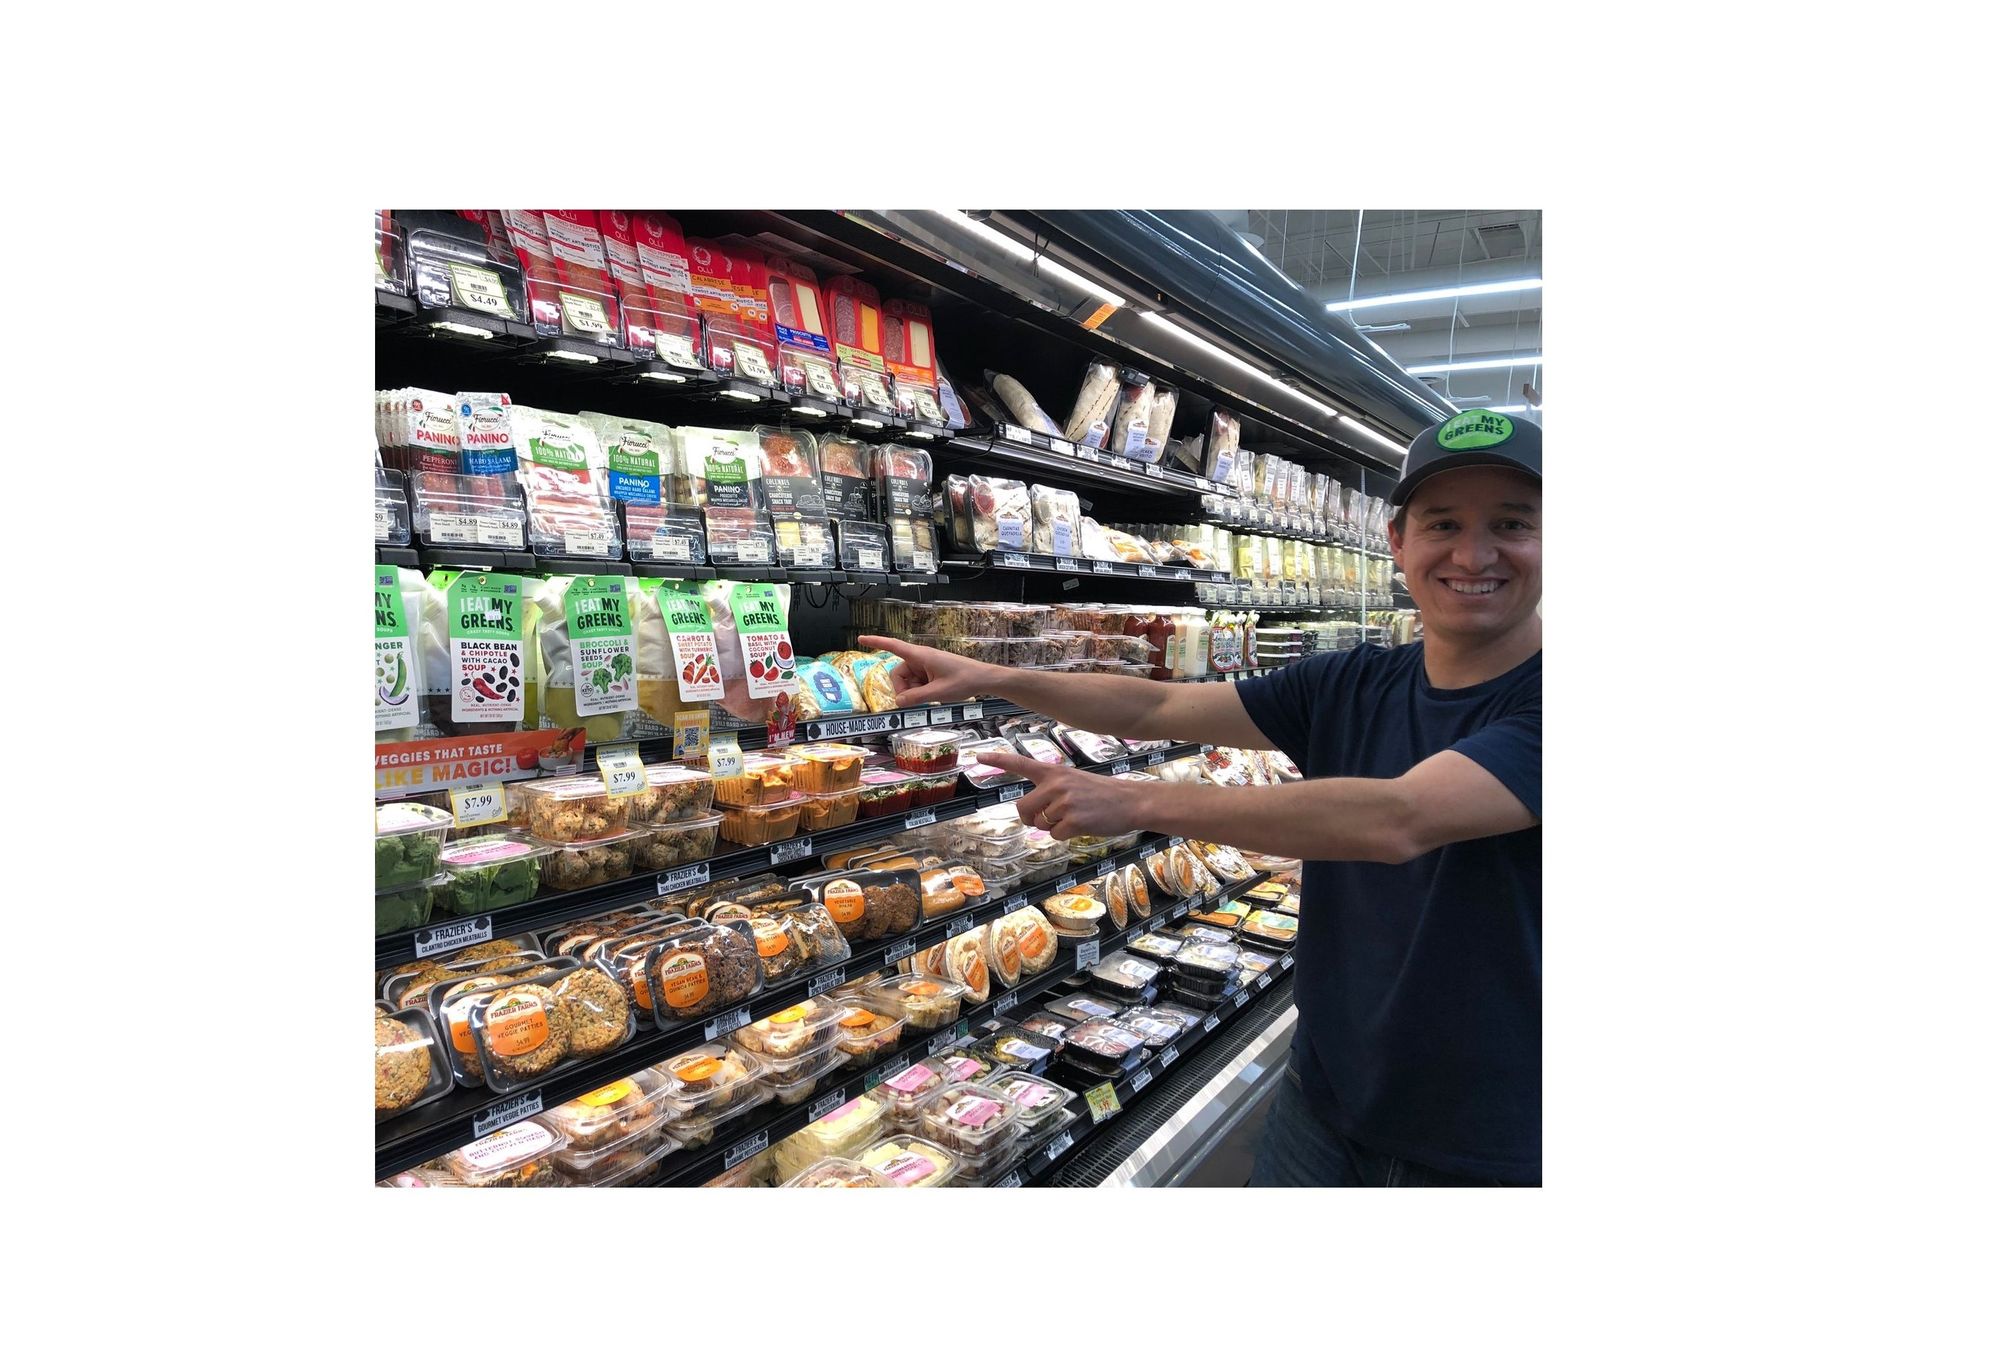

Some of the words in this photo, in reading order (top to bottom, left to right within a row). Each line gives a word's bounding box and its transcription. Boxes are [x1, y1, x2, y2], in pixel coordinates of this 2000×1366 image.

[614, 231, 630, 242] OLLI
[648, 238, 664, 248] OLLI
[698, 266, 713, 275] OLLI
[692, 275, 725, 286] CALABRESE
[470, 294, 498, 306] $4.49
[579, 319, 603, 329] $1.99
[425, 411, 452, 425] Fiorucci
[473, 414, 499, 423] Fiorucci
[1481, 415, 1504, 427] MY
[417, 429, 460, 446] PANINO
[1445, 423, 1504, 440] GREENS
[467, 433, 509, 443] PANINO
[621, 436, 648, 449] Fiorucci
[535, 446, 554, 457] 100%
[713, 446, 735, 457] Fiorucci
[469, 457, 486, 465] HARD
[488, 456, 512, 464] SALAMI
[613, 454, 630, 464] 100%
[631, 456, 655, 468] NATURAL
[722, 464, 743, 474] NATURAL
[619, 478, 649, 488] PANINO
[714, 485, 740, 493] PANINO
[459, 517, 477, 526] $4.89
[502, 521, 518, 529] $4.89
[461, 598, 465, 613] I
[467, 597, 490, 612] EAT
[492, 598, 512, 614] MY
[581, 599, 600, 613] EAT
[601, 598, 619, 612] MY
[759, 601, 775, 612] MY
[580, 640, 621, 648] BROCCOLI
[746, 634, 778, 642] TOMATO
[461, 642, 491, 651] BLACK
[493, 643, 517, 651] BEAN
[580, 646, 629, 655] SUNFLOWER
[826, 720, 866, 736] HOUSE-MADE
[867, 717, 886, 731] SOUPS
[769, 732, 780, 743] I'M
[782, 729, 795, 739] NEW
[436, 747, 465, 760] THAT
[468, 744, 502, 756] TASTE
[717, 757, 735, 767] $7.99
[375, 766, 424, 789] LIKE
[432, 758, 511, 783] MAGIC!
[613, 771, 636, 784] $7.99
[464, 795, 492, 810] $7.99
[670, 868, 697, 881] FRAZIER'S
[660, 884, 669, 893] THAI
[670, 880, 686, 891] CHICKEN
[686, 875, 708, 888] MEATBALLS
[435, 923, 473, 940] FRAZIER'S
[421, 942, 443, 953] CILANTRO
[444, 938, 462, 948] CHICKEN
[463, 931, 488, 943] MEATBALLS
[665, 965, 684, 975] FRAZIER
[685, 961, 701, 970] FARMS
[669, 985, 687, 993] QUINOA
[688, 980, 705, 988] PATTIES
[671, 979, 686, 987] VEGAN
[491, 1006, 517, 1019] FRAZIER
[518, 1001, 538, 1011] FARMS
[497, 1028, 518, 1038] VEGGIE
[520, 1022, 543, 1032] PATTIES
[505, 1019, 532, 1030] GOURMET
[491, 1095, 527, 1117] FRAZIER'S
[478, 1117, 501, 1133] GOURMET
[502, 1111, 519, 1122] VEGGIE
[520, 1101, 539, 1115] PATTIES
[736, 1136, 757, 1154] FRAZIER'S
